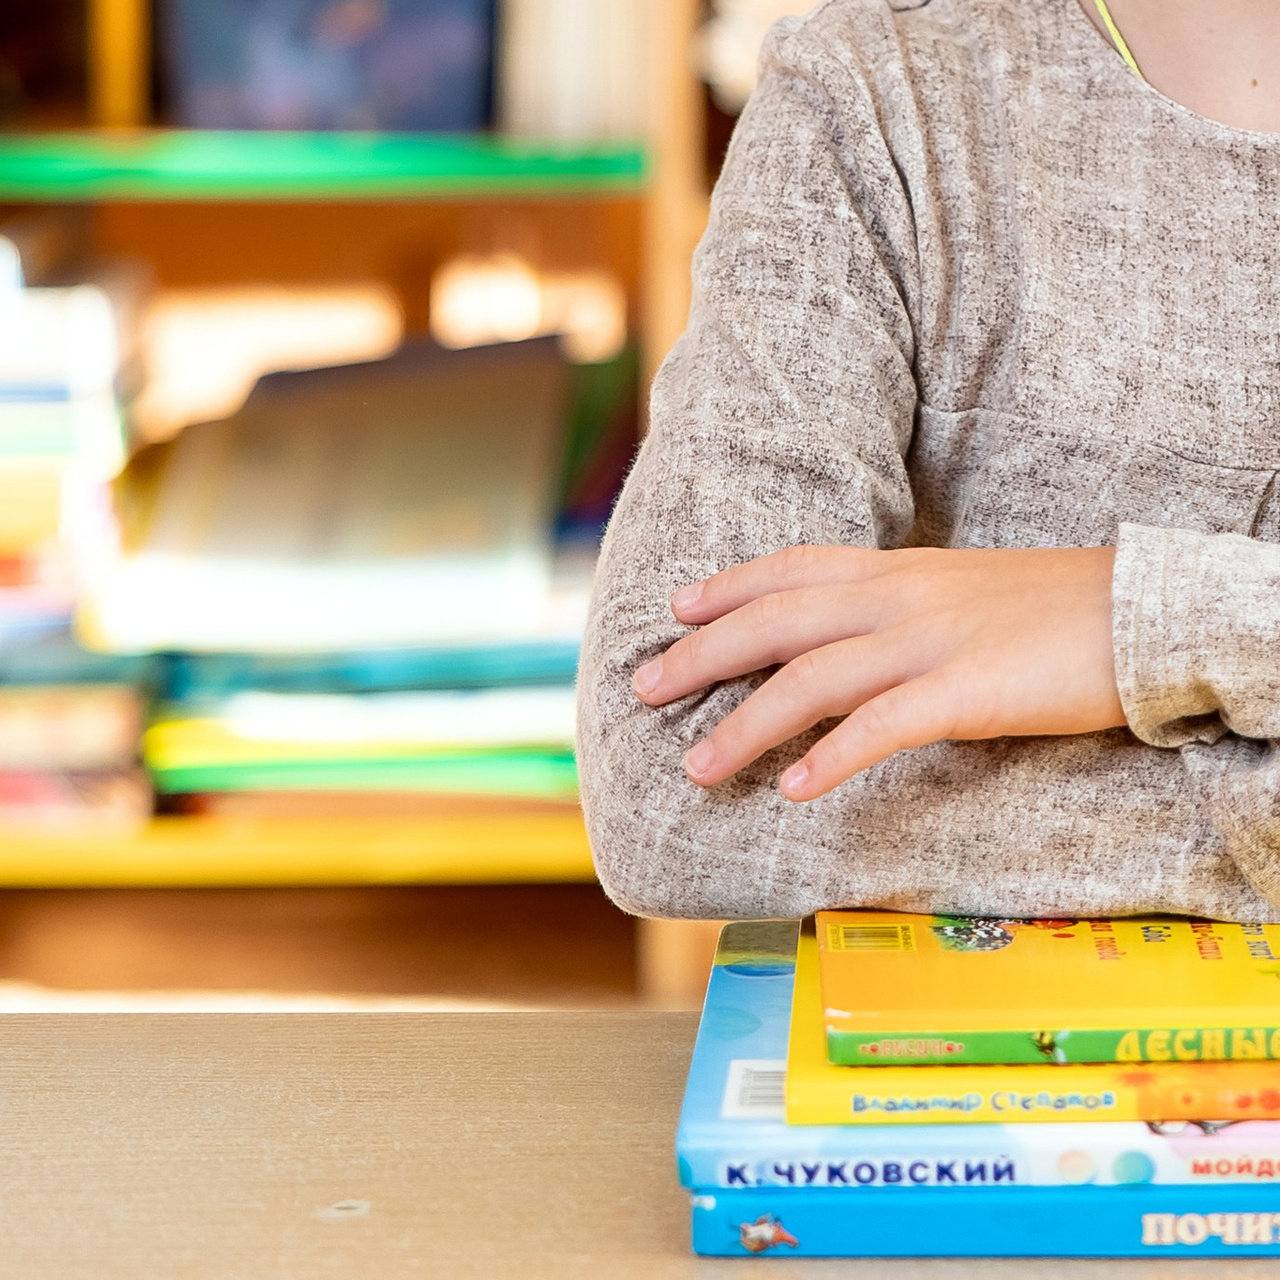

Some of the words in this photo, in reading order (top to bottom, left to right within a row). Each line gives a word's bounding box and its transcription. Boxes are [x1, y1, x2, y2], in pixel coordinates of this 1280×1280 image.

[1141, 925, 1172, 942] Сова
[991, 1091, 1116, 1111] Степанов
[726, 1162, 763, 1186] К.
[773, 1154, 1016, 1184] ЧУКОВСКИЙ
